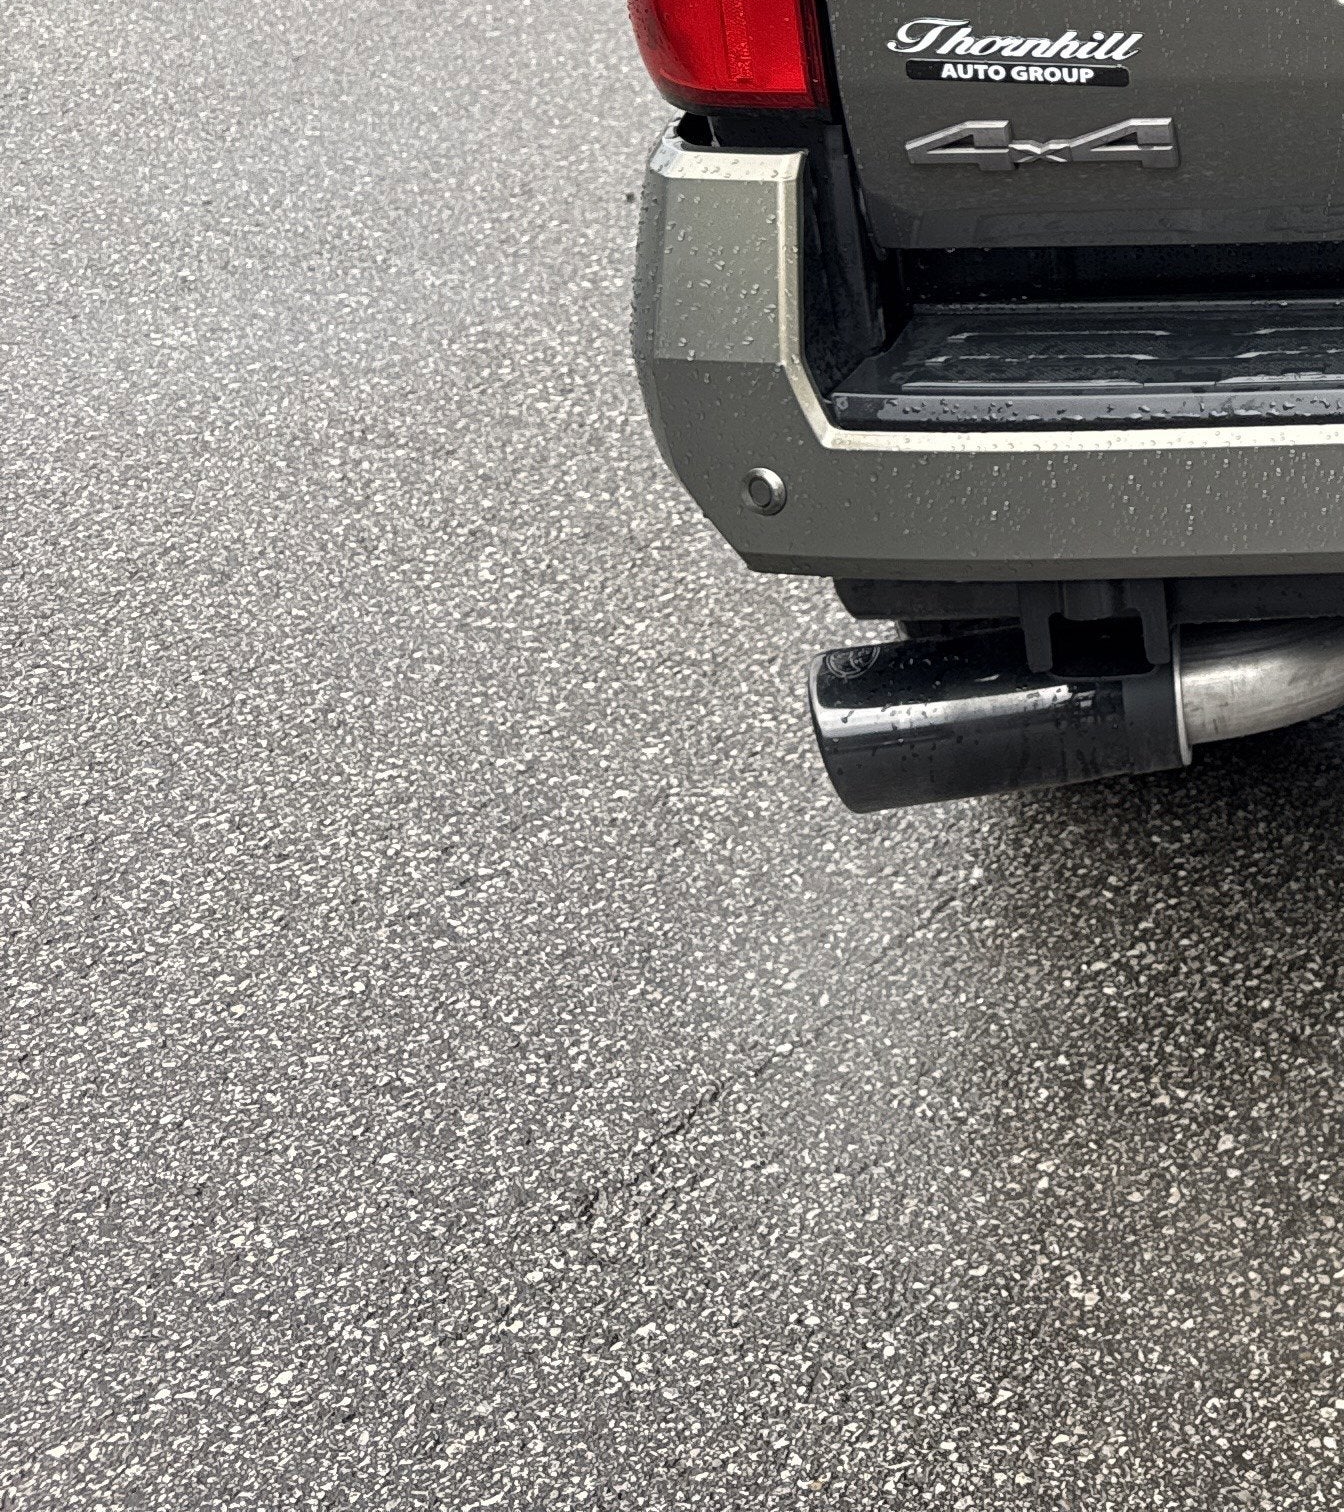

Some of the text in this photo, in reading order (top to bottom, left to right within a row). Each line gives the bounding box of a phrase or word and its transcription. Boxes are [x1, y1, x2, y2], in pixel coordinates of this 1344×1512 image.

[887, 17, 1145, 60] Thornhill
[940, 63, 1095, 84] AUTO GROUP
